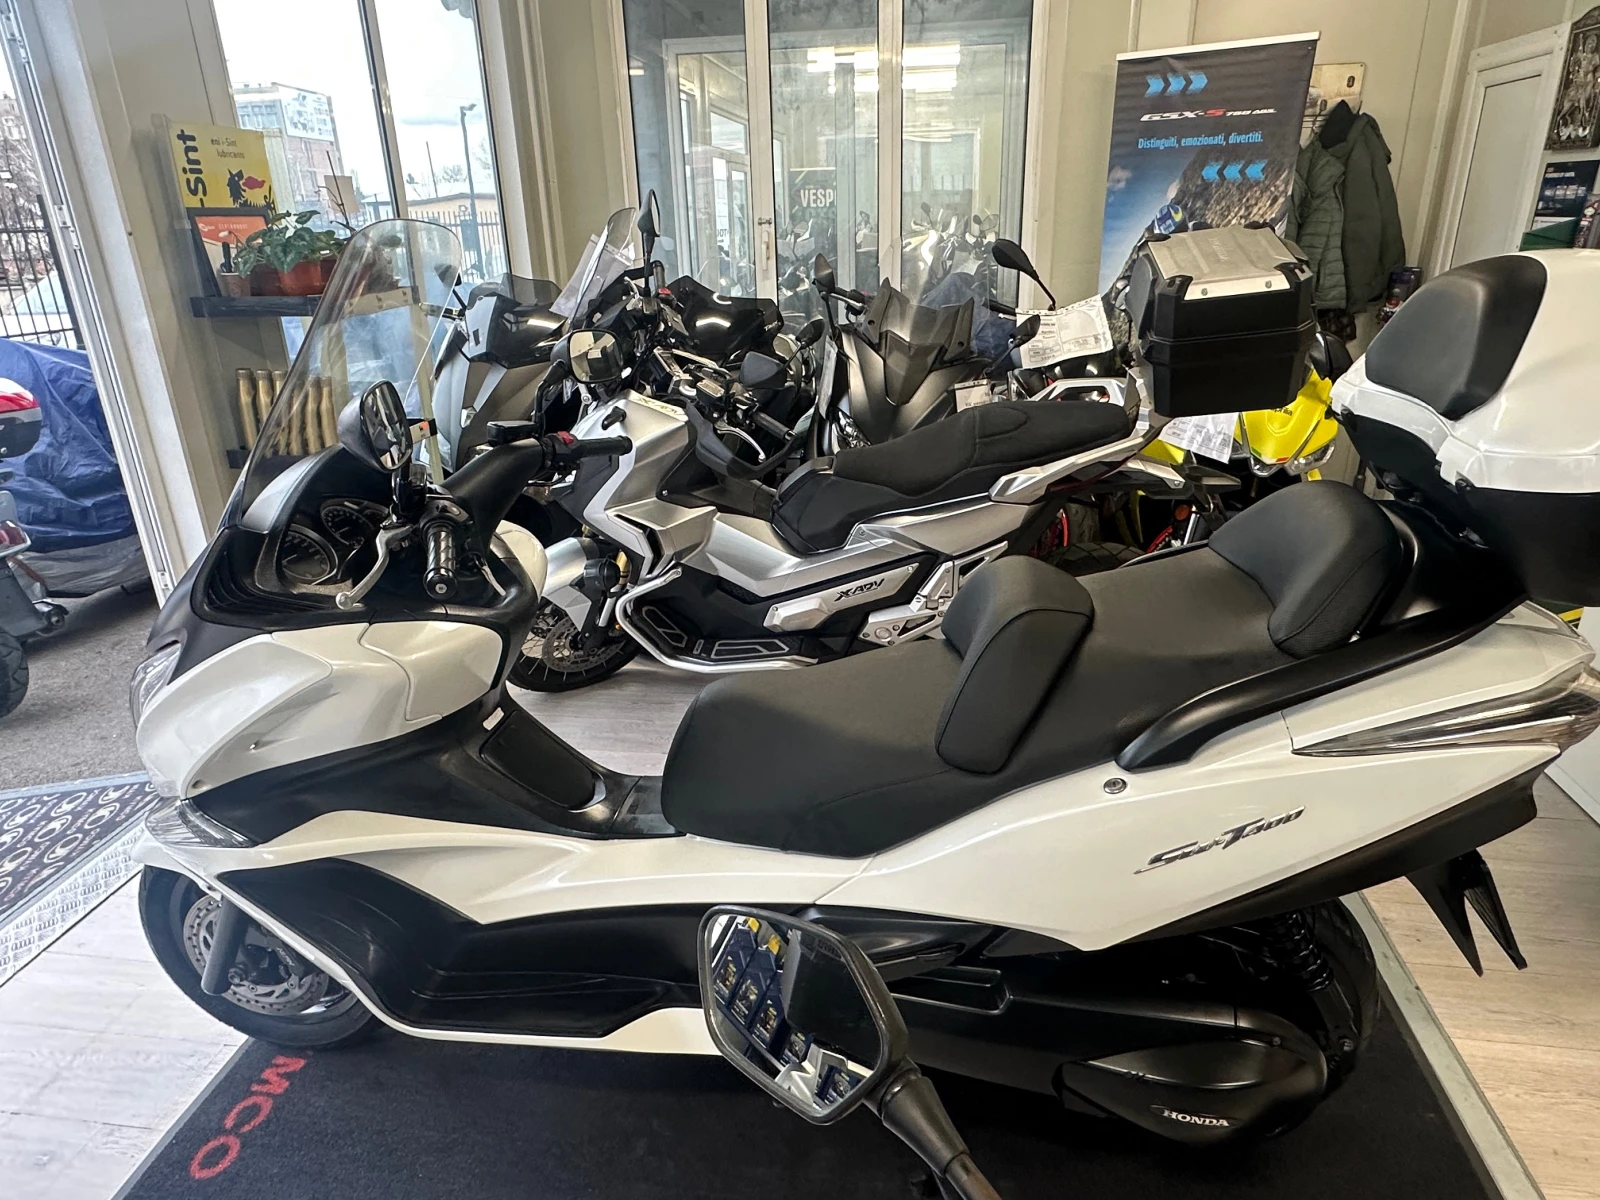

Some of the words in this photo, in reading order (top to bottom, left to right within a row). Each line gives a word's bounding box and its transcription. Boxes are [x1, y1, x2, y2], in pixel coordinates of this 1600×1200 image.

[1181, 133, 1226, 147] emozionati,
[1229, 131, 1263, 144] divertiti.
[800, 188, 837, 208] VESP
[834, 578, 885, 602] X-ADV
[188, 1054, 308, 1180] MCO
[1162, 1109, 1230, 1127] HONDA
